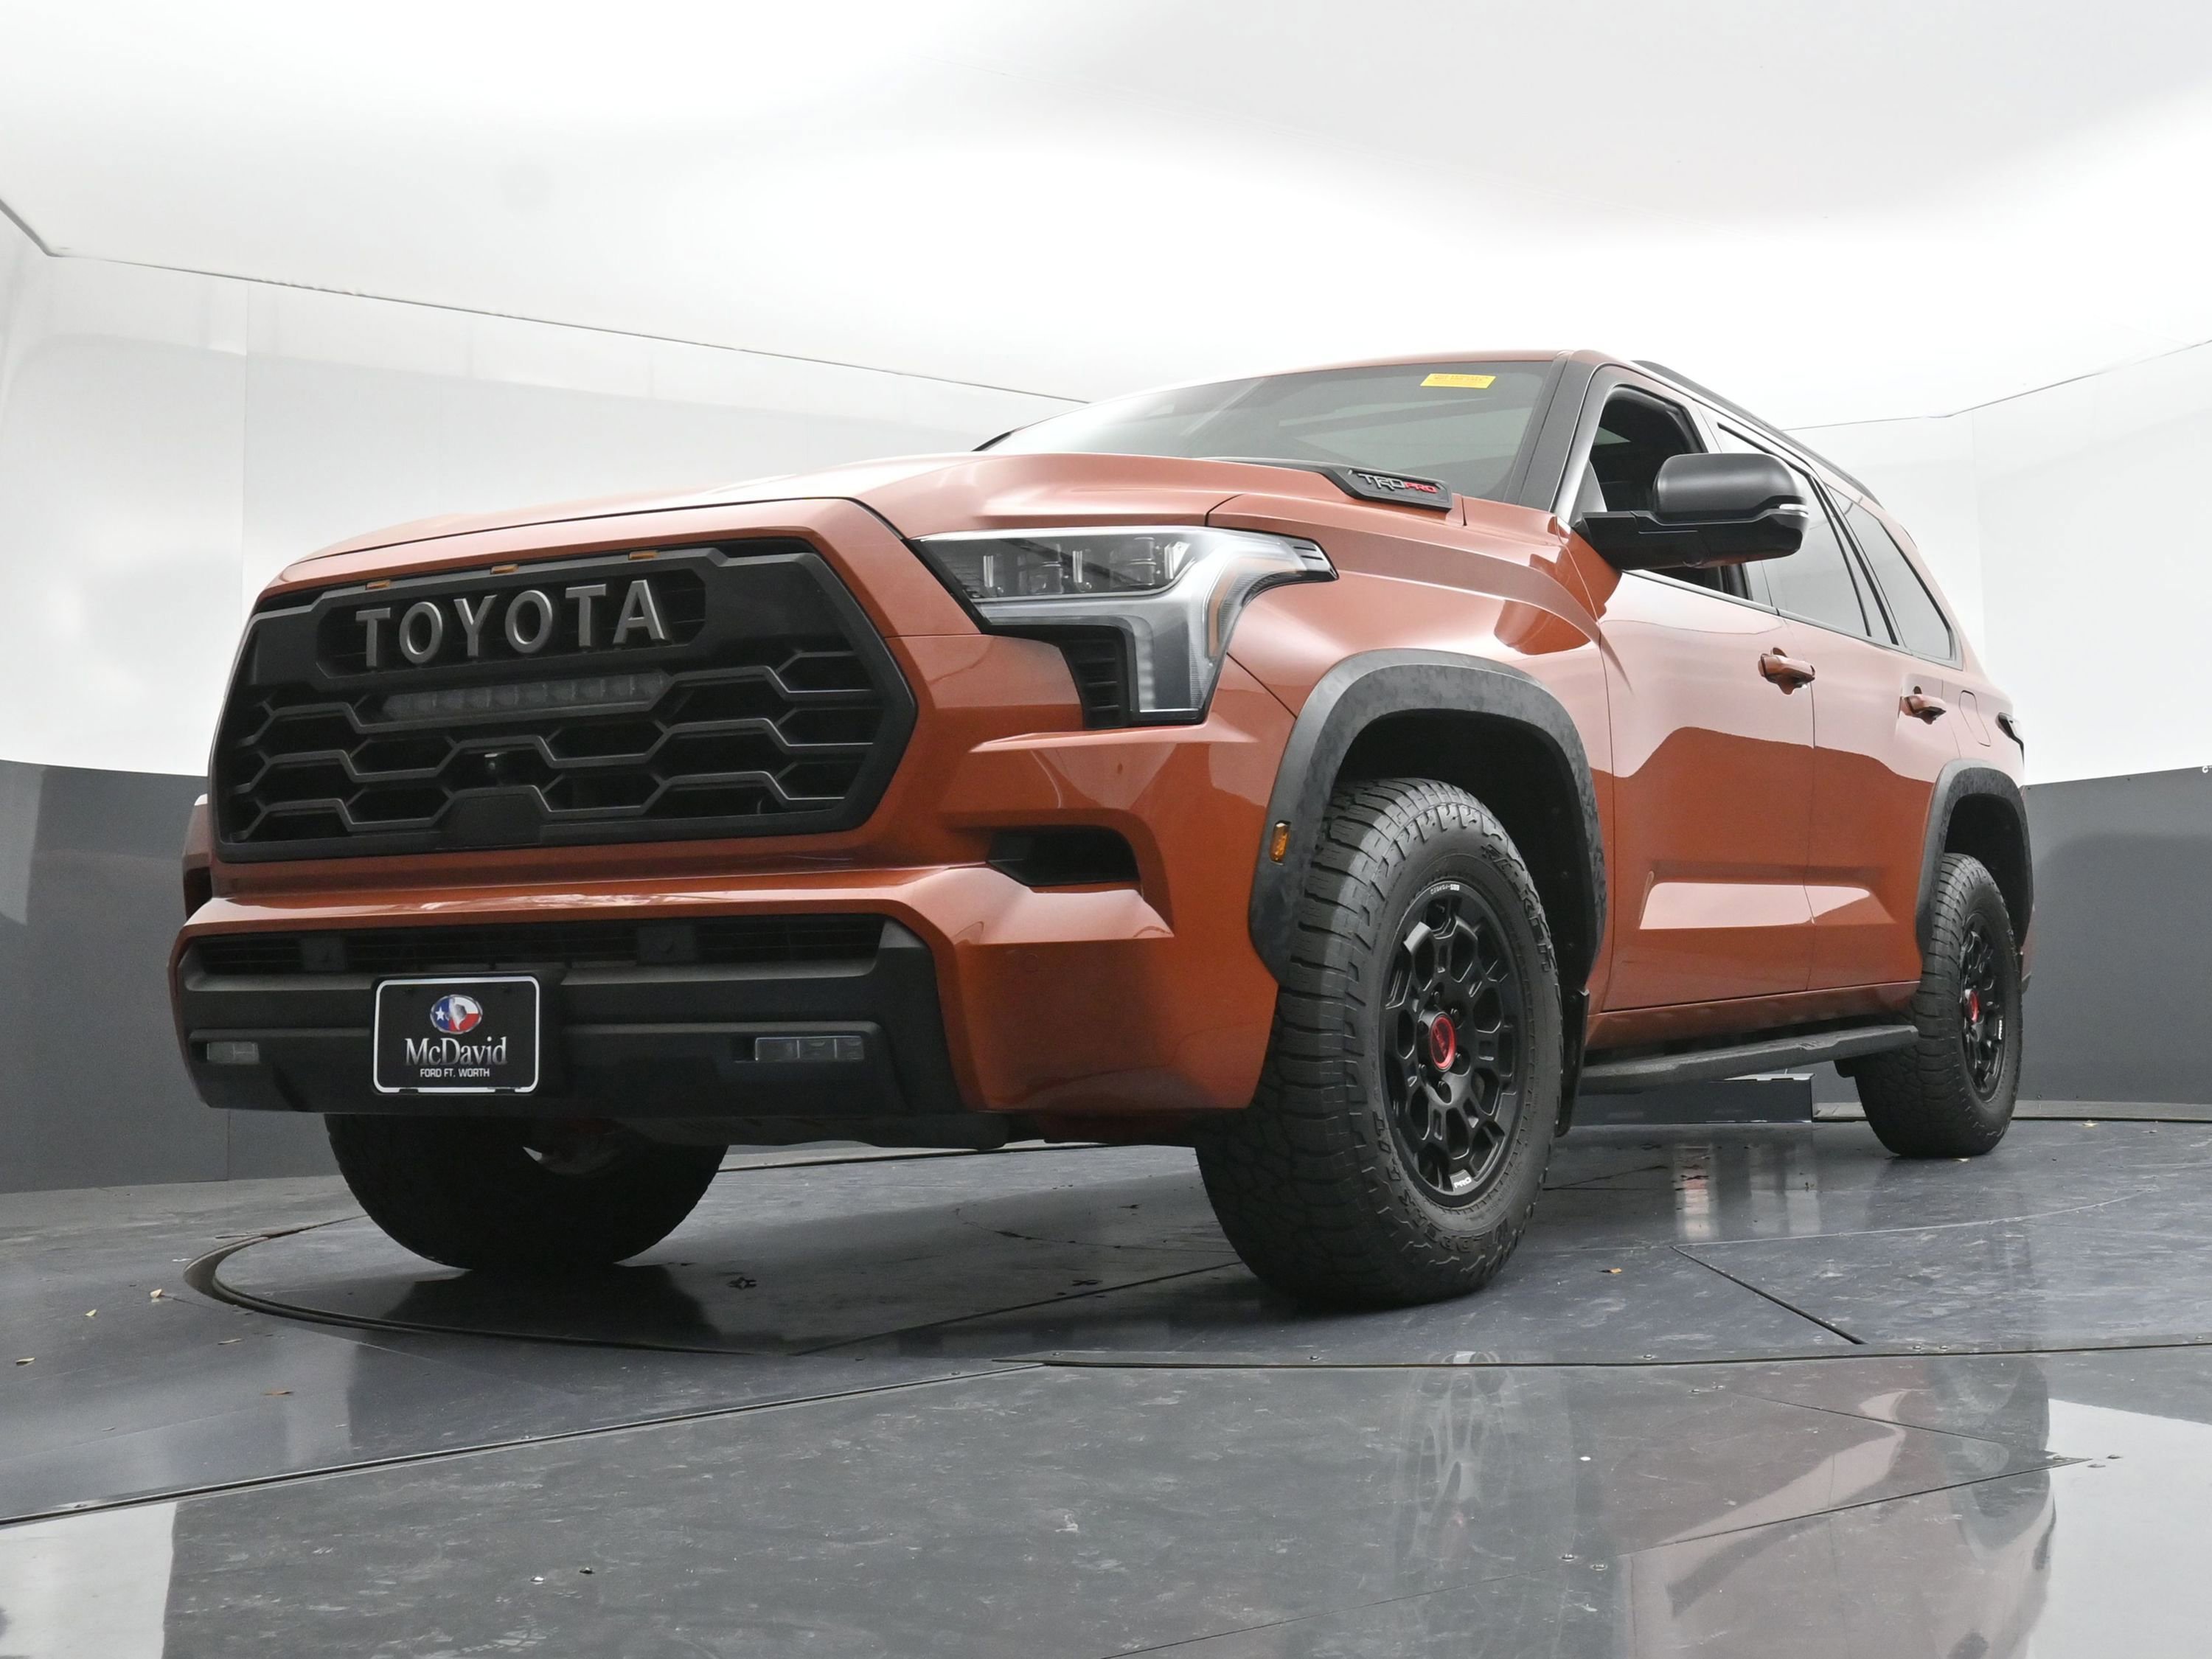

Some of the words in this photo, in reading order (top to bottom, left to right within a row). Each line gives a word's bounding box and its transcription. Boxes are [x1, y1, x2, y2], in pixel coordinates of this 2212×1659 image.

[1357, 473, 1405, 491] TRD
[1405, 481, 1437, 494] PRO
[355, 580, 669, 667] TOYOTA
[405, 1036, 507, 1066] McDavid
[420, 1068, 442, 1077] FORD
[444, 1068, 456, 1077] FT.
[459, 1068, 490, 1077] WORTH
[1453, 1177, 1472, 1189] PRO
